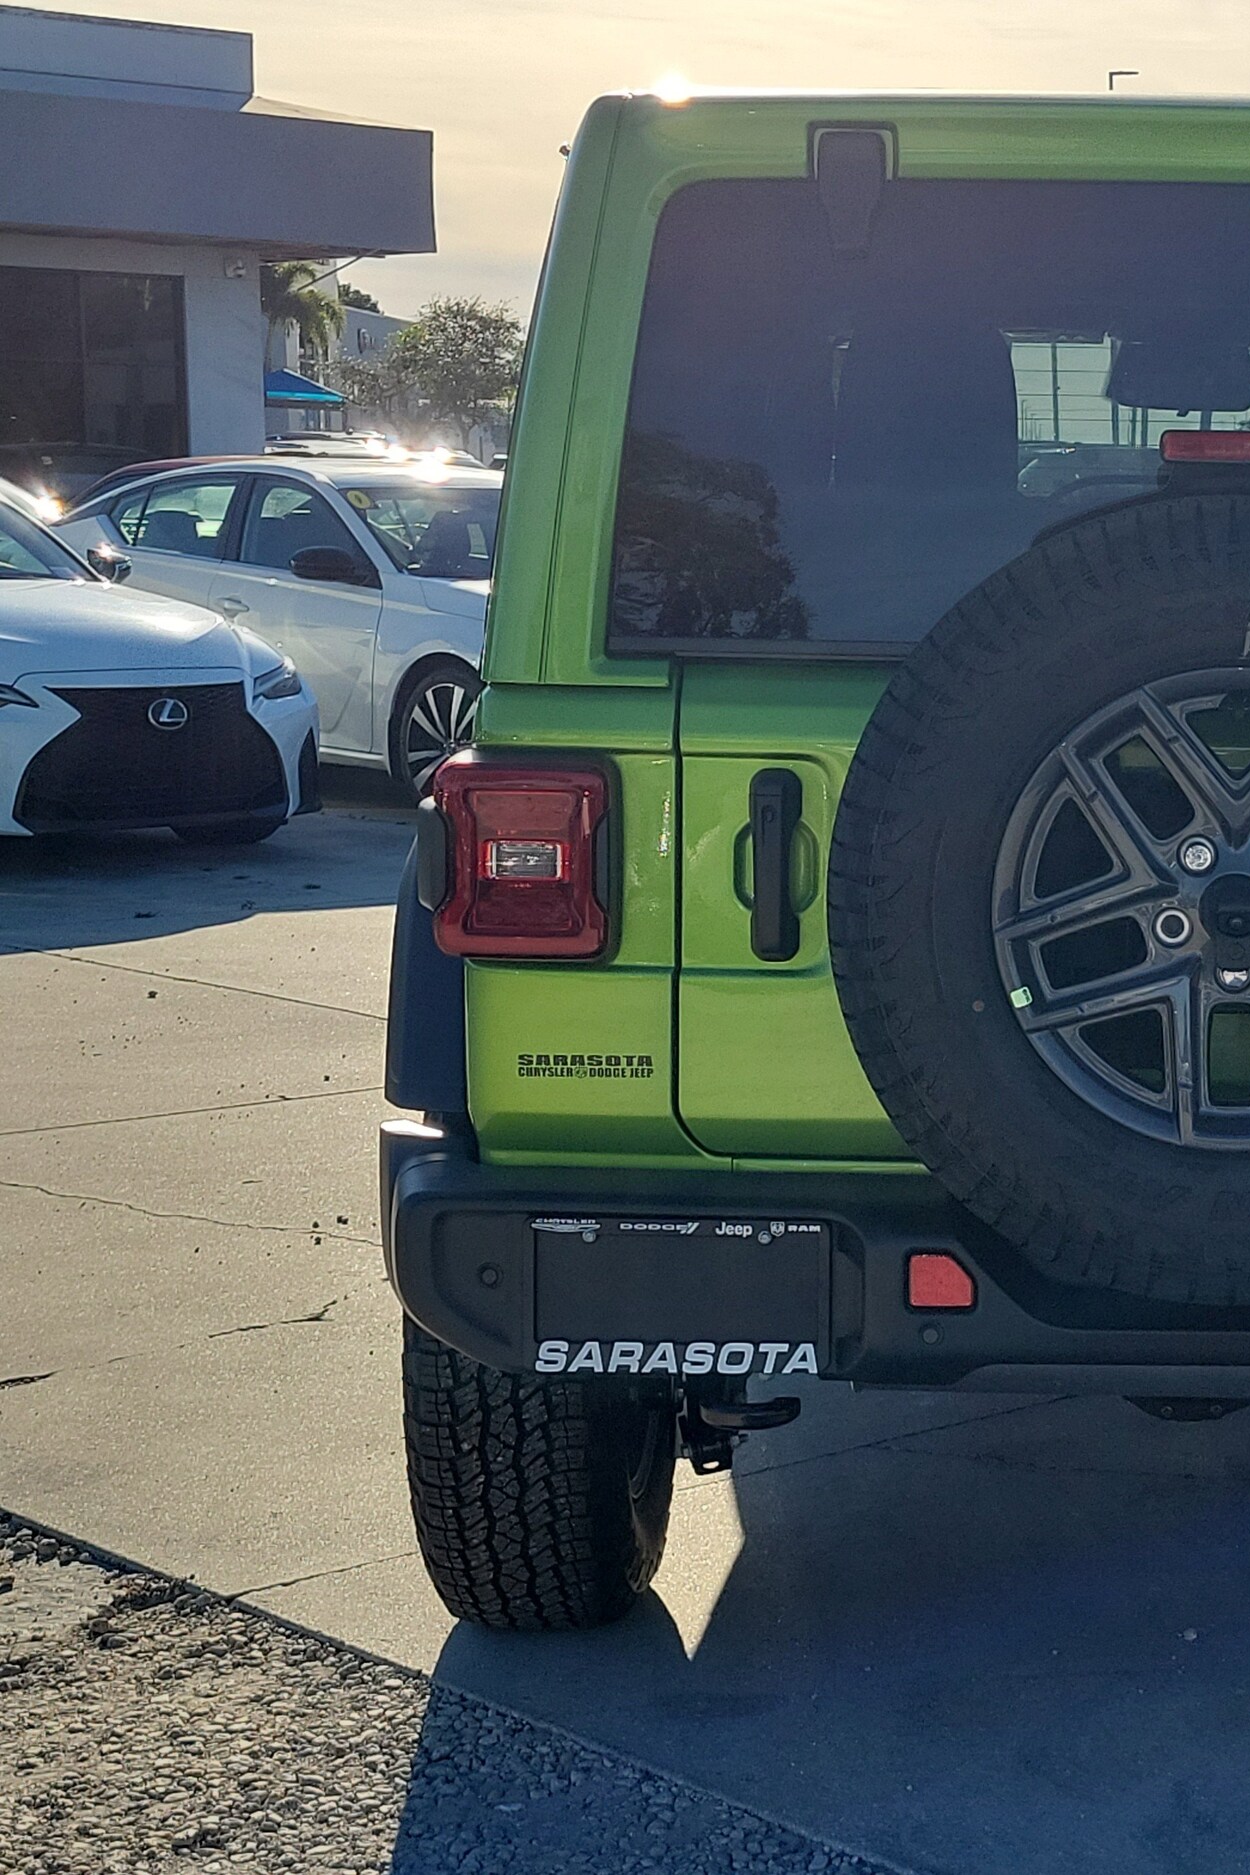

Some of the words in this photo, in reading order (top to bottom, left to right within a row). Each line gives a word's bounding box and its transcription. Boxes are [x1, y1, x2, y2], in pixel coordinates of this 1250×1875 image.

[518, 1054, 653, 1066] SARASOTA
[518, 1067, 573, 1078] CHRYSLER
[589, 1067, 626, 1078] DODGE
[629, 1067, 653, 1078] JEEP
[620, 1223, 688, 1231] DODGE
[715, 1221, 753, 1239] Jeep
[787, 1224, 821, 1233] RAM
[535, 1340, 818, 1374] SARASOTA
